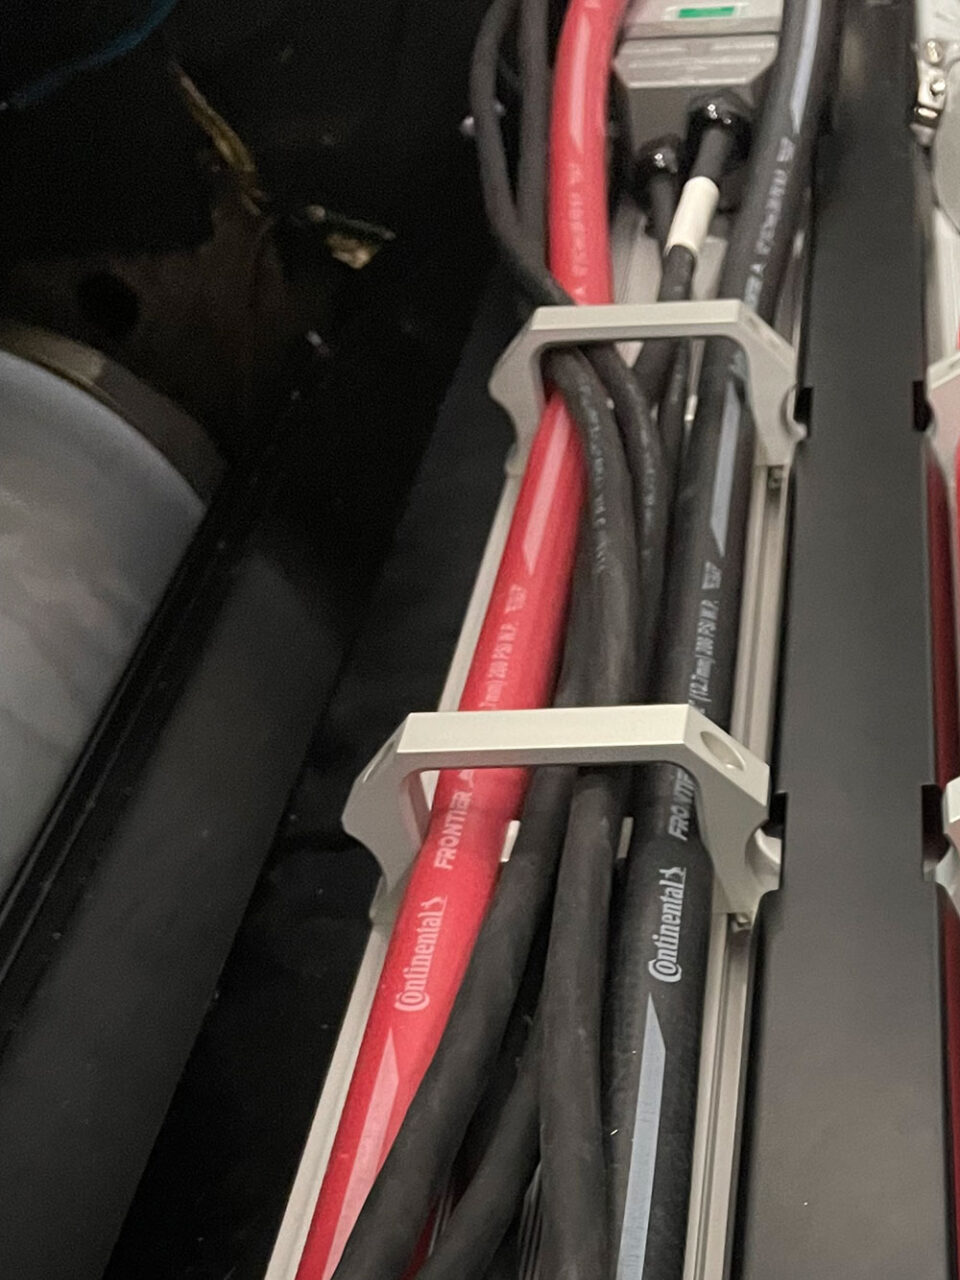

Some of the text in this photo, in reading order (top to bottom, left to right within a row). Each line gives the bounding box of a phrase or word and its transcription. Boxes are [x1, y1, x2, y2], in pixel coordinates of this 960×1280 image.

[393, 791, 473, 1013] Continental FRONTIER
[648, 879, 686, 984] Continental
